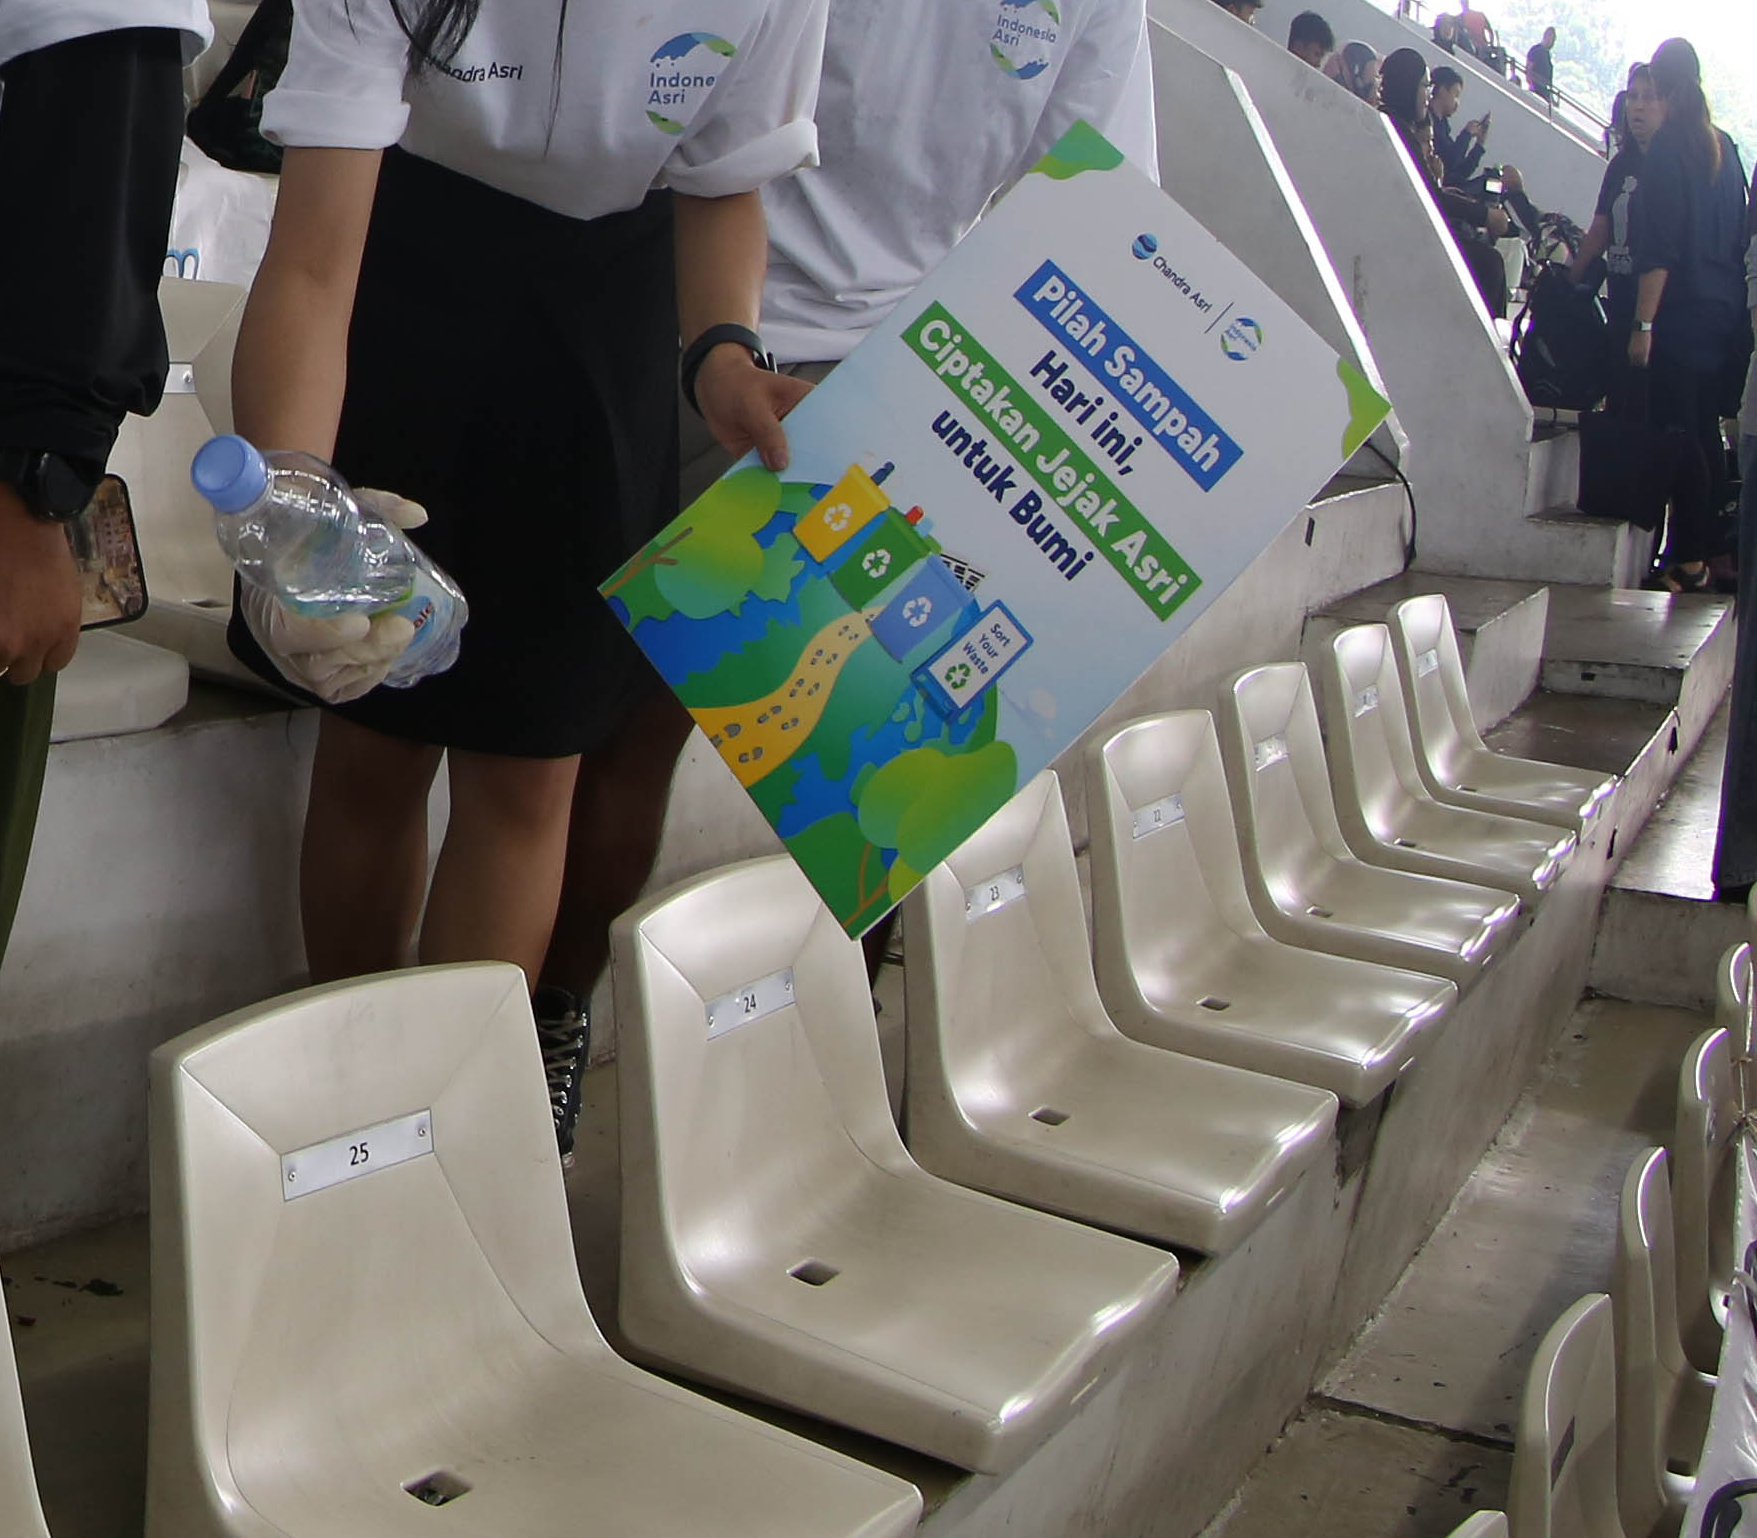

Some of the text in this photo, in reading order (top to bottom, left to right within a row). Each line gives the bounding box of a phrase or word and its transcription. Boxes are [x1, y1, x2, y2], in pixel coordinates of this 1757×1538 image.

[991, 28, 1021, 47] Asri
[996, 13, 1057, 44] Indonesia
[487, 61, 524, 81] Asri
[649, 70, 716, 89] Indone
[647, 87, 687, 106] Asri
[1152, 255, 1213, 313] Chandra Asri
[1031, 274, 1222, 473] Pilah Sampah
[1028, 349, 1144, 477] Hari ini,
[918, 319, 1189, 605] Ciptakan Jejak Asri
[930, 409, 1095, 582] untuk Bumi
[977, 633, 999, 660] Your
[990, 622, 1012, 649] Sort
[962, 640, 990, 676] Waste
[989, 885, 1000, 902] 23
[743, 993, 757, 1014] 24
[348, 1141, 370, 1167] 25
